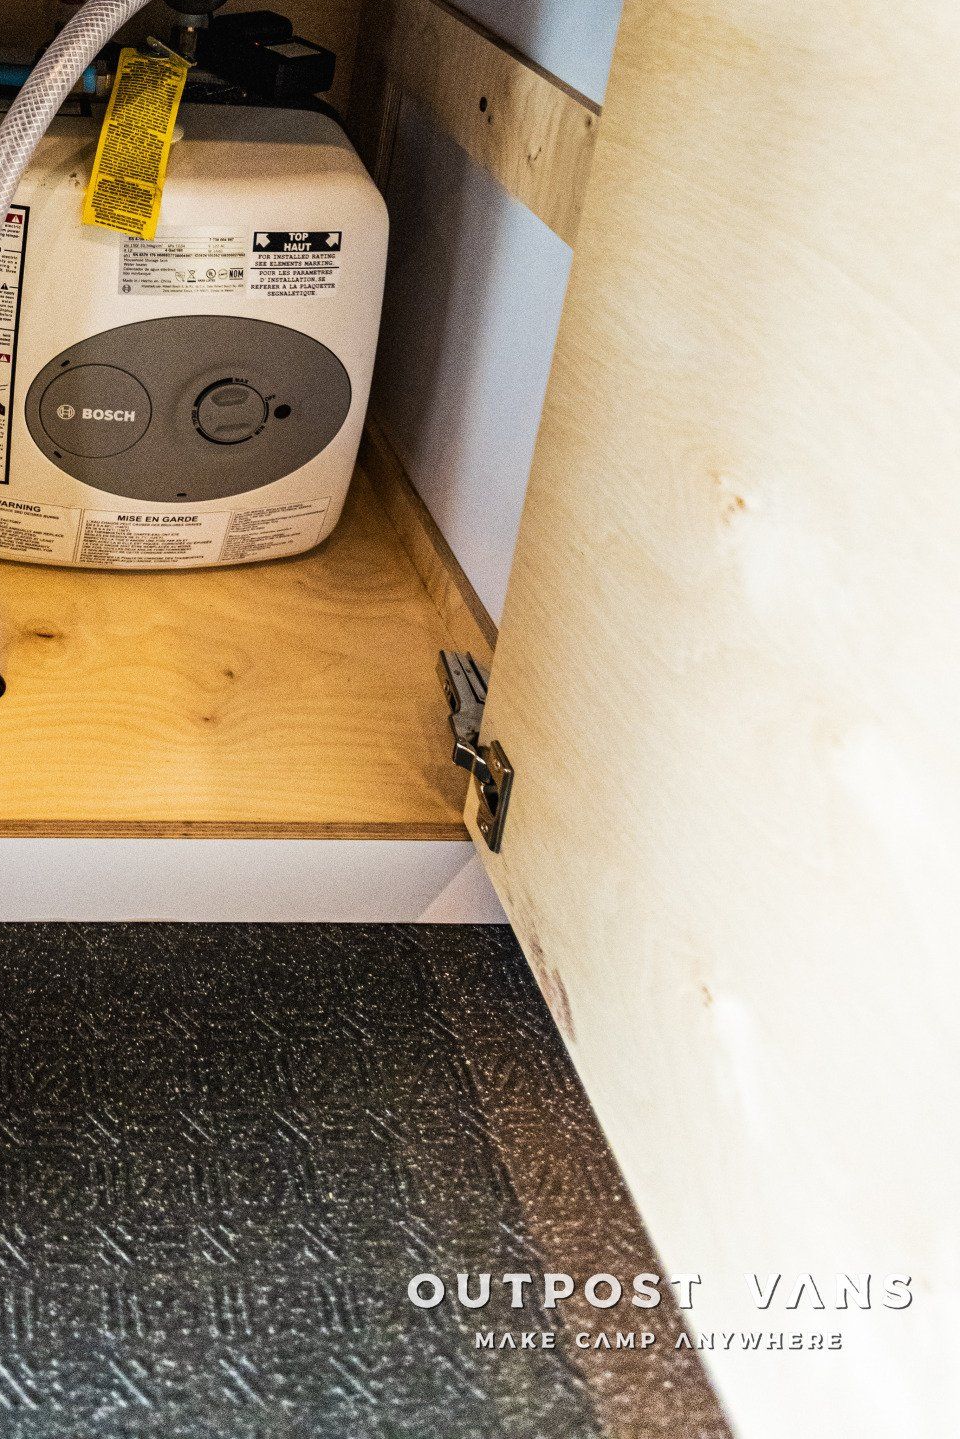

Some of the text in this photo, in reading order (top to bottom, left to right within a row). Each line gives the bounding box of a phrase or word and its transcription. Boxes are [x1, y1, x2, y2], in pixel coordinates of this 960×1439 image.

[289, 232, 309, 242] TOP
[283, 242, 312, 252] HAUT
[229, 269, 244, 279] NOM
[81, 408, 136, 423] BOSCH
[161, 515, 199, 523] GARDE
